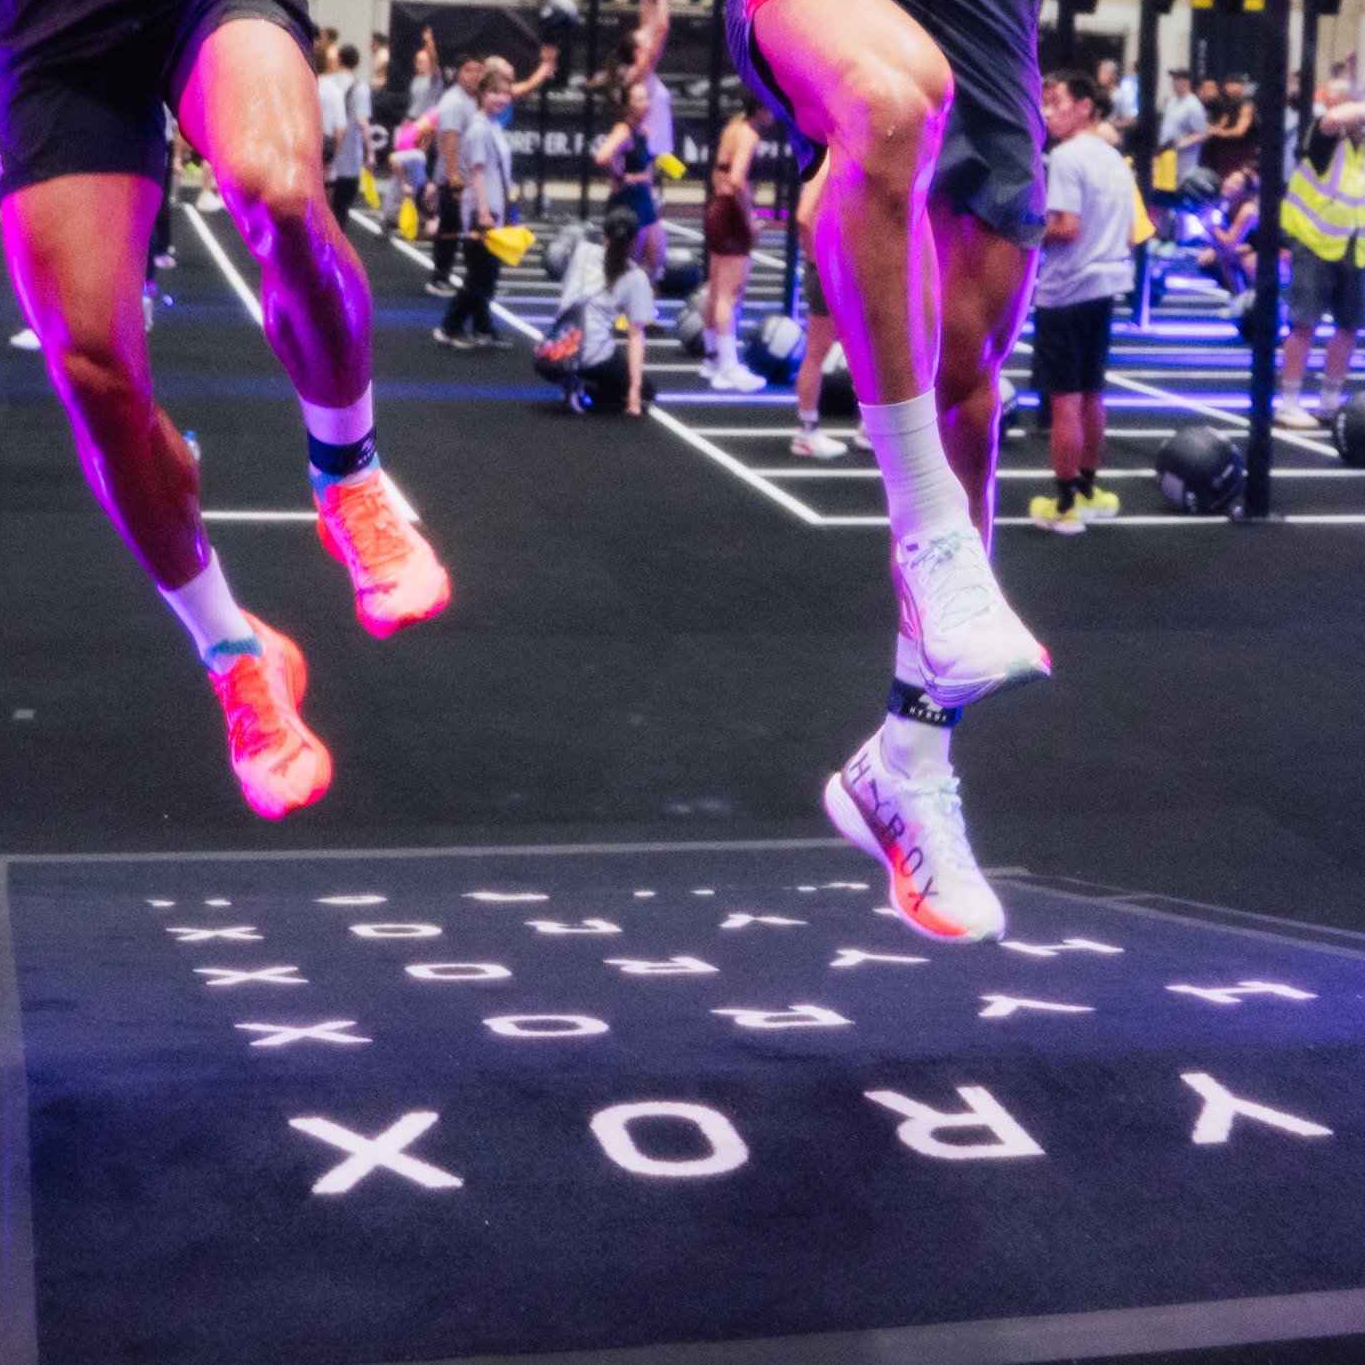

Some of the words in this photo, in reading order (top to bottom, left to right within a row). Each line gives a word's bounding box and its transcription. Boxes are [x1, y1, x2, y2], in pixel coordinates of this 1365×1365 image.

[849, 753, 940, 913] HYROX
[165, 907, 899, 942] YROX
[192, 938, 1125, 986] HYROX
[234, 980, 1319, 1047] HYROX
